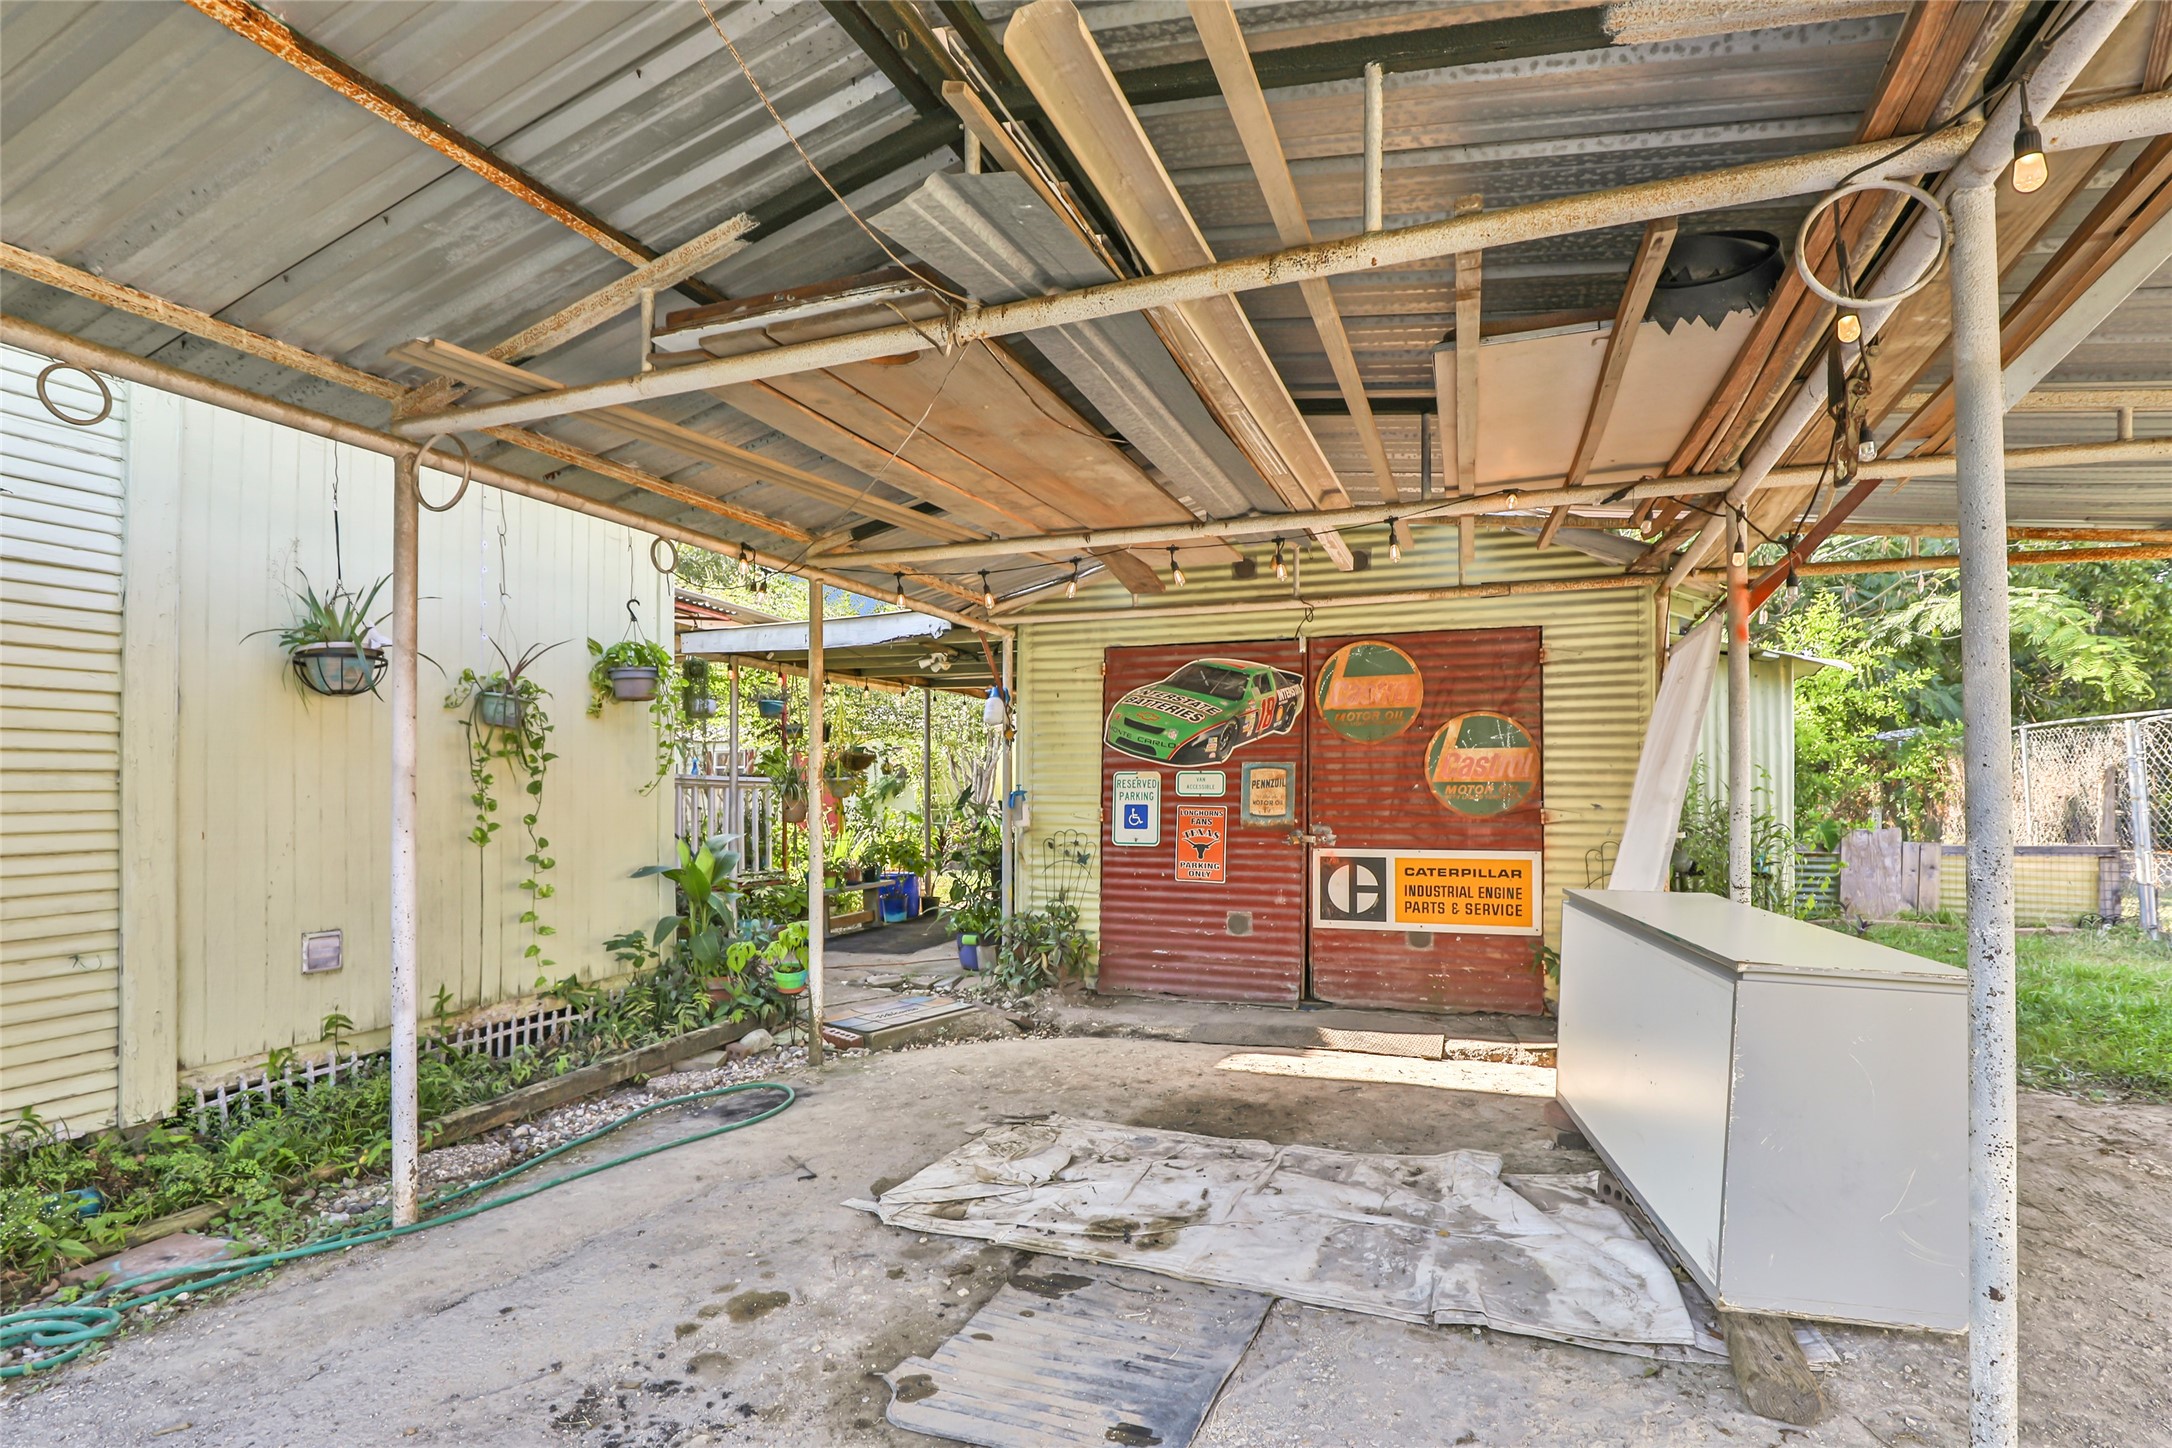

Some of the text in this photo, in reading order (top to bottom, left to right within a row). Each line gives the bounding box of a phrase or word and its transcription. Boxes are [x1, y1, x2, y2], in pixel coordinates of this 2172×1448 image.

[1124, 696, 1205, 722] BATTERIES
[1255, 696, 1277, 733] 18
[1335, 710, 1404, 722] MOTOR OIL
[1136, 736, 1177, 749] CARLO
[1442, 752, 1534, 778] Castrol
[1116, 779, 1157, 789] RESERVED
[1251, 778, 1287, 790] PENNZOIL
[1119, 791, 1155, 801] PARKING
[1180, 809, 1224, 817] LONGHORNS
[1191, 818, 1213, 826] FANS
[1182, 828, 1221, 840] TEXAS
[1180, 862, 1220, 870] PARKING
[1188, 870, 1211, 878] ONLY
[1404, 867, 1523, 879] CATERPILLAR
[1404, 884, 1523, 900] INDUSTRIAL ENGINE
[1404, 901, 1523, 917] PARTS & SERVICE
